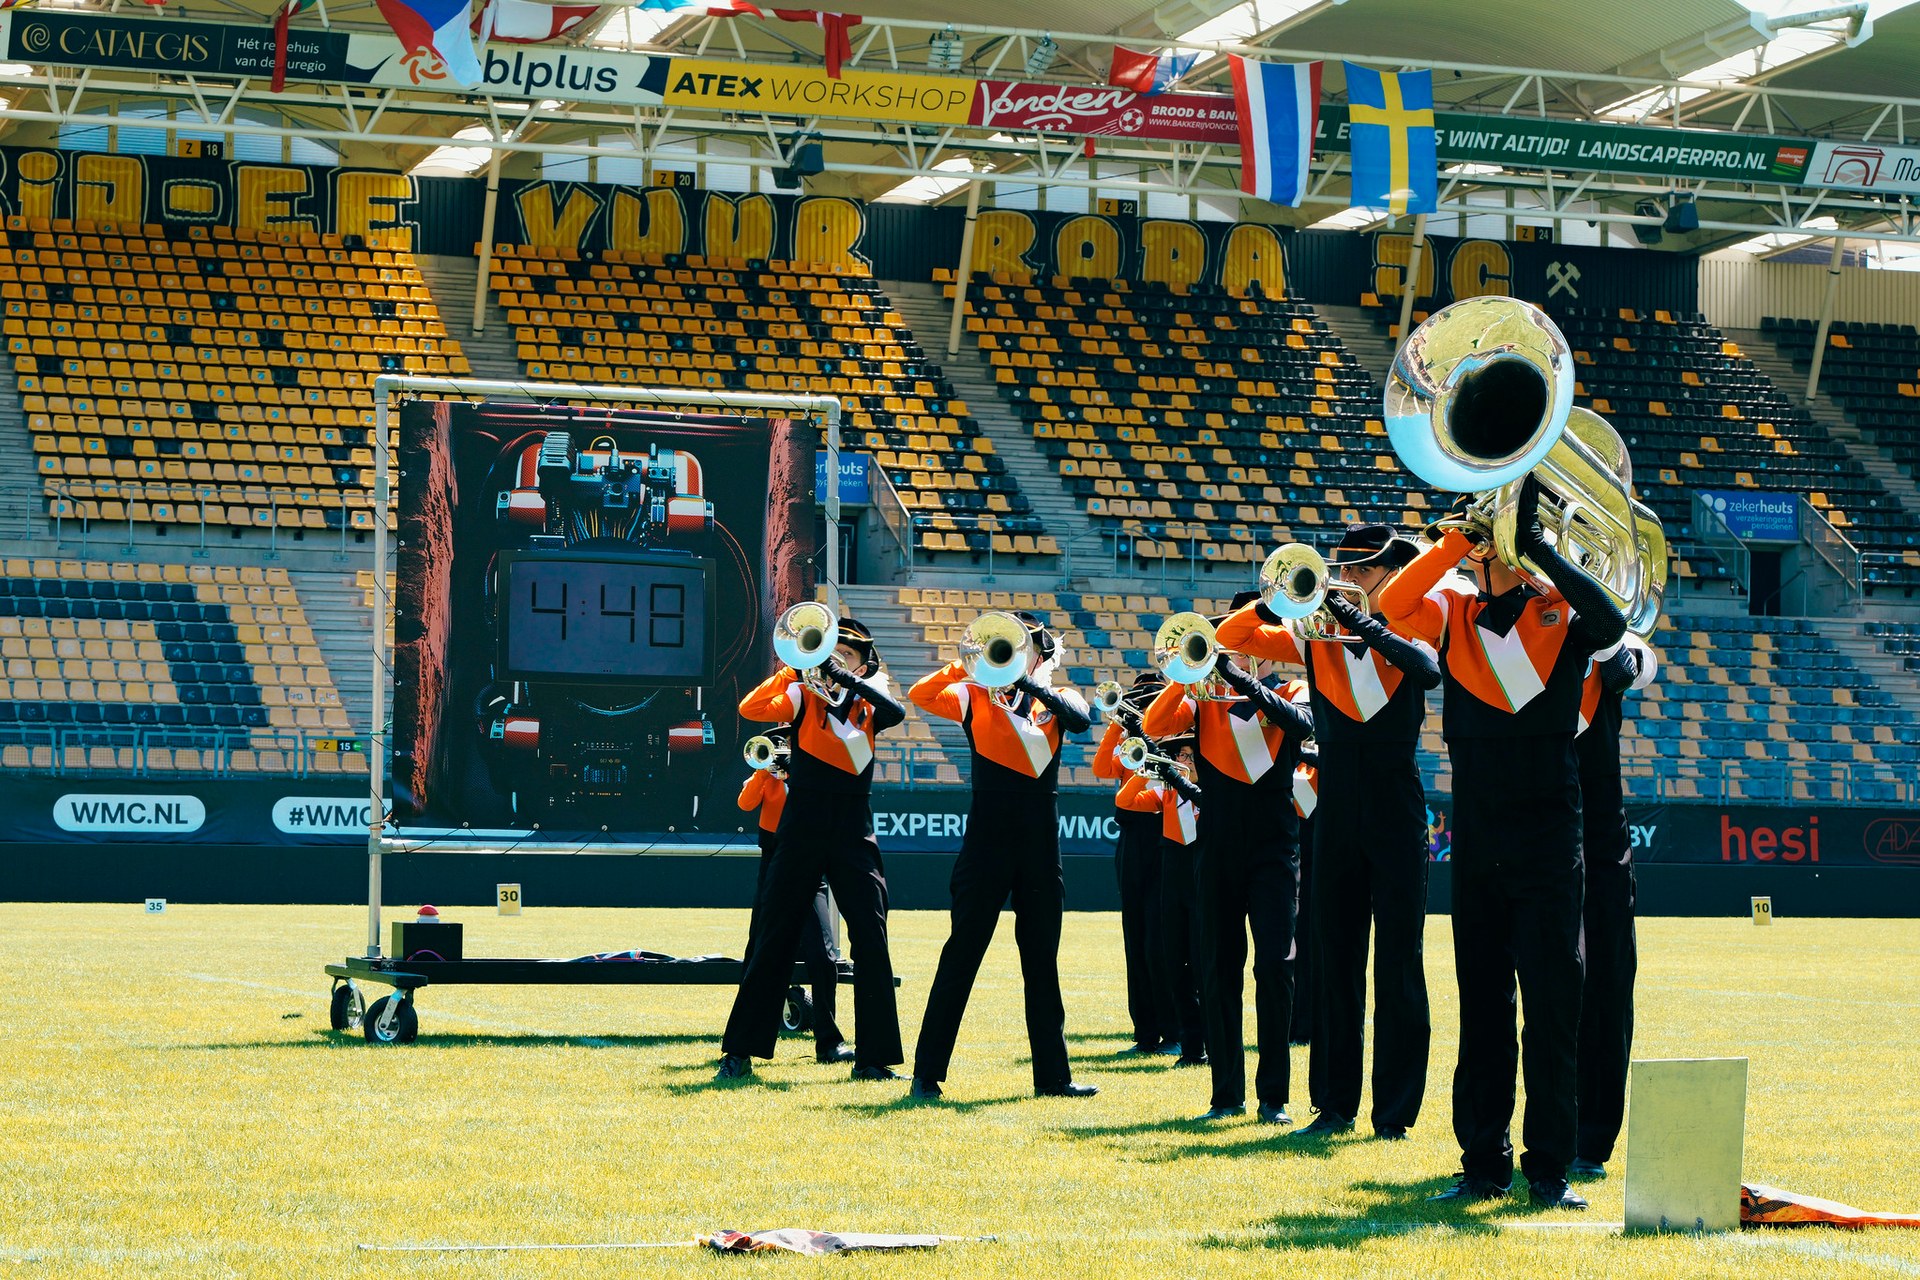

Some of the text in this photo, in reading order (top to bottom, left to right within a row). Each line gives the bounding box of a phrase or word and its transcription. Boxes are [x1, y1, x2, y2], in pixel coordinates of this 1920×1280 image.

[59, 26, 208, 62] CATAEGIS
[237, 38, 259, 50] Hét
[235, 57, 326, 73] van de uregio
[672, 72, 967, 112] ATEX WORKSHOP
[981, 81, 1138, 127] Voncken
[1151, 105, 1194, 118] BROOD
[1197, 109, 1206, 119] &
[185, 142, 218, 156] Z 18
[1449, 130, 1502, 150] WINT
[1502, 134, 1569, 156] ALTIJD!
[1577, 140, 1767, 170] LANDSCAPERPRO.NL
[660, 173, 691, 186] Z 20
[1105, 201, 1133, 214] Z 22
[1522, 228, 1549, 240] Z 24
[1729, 498, 1793, 514] zekerheuts
[531, 581, 685, 648] 4:48
[323, 741, 351, 751] Z 15
[71, 801, 188, 825] WMC.NL
[1721, 815, 1819, 862] hesi
[500, 890, 519, 902] 30
[149, 902, 162, 911] 35
[1754, 902, 1769, 913] 10
